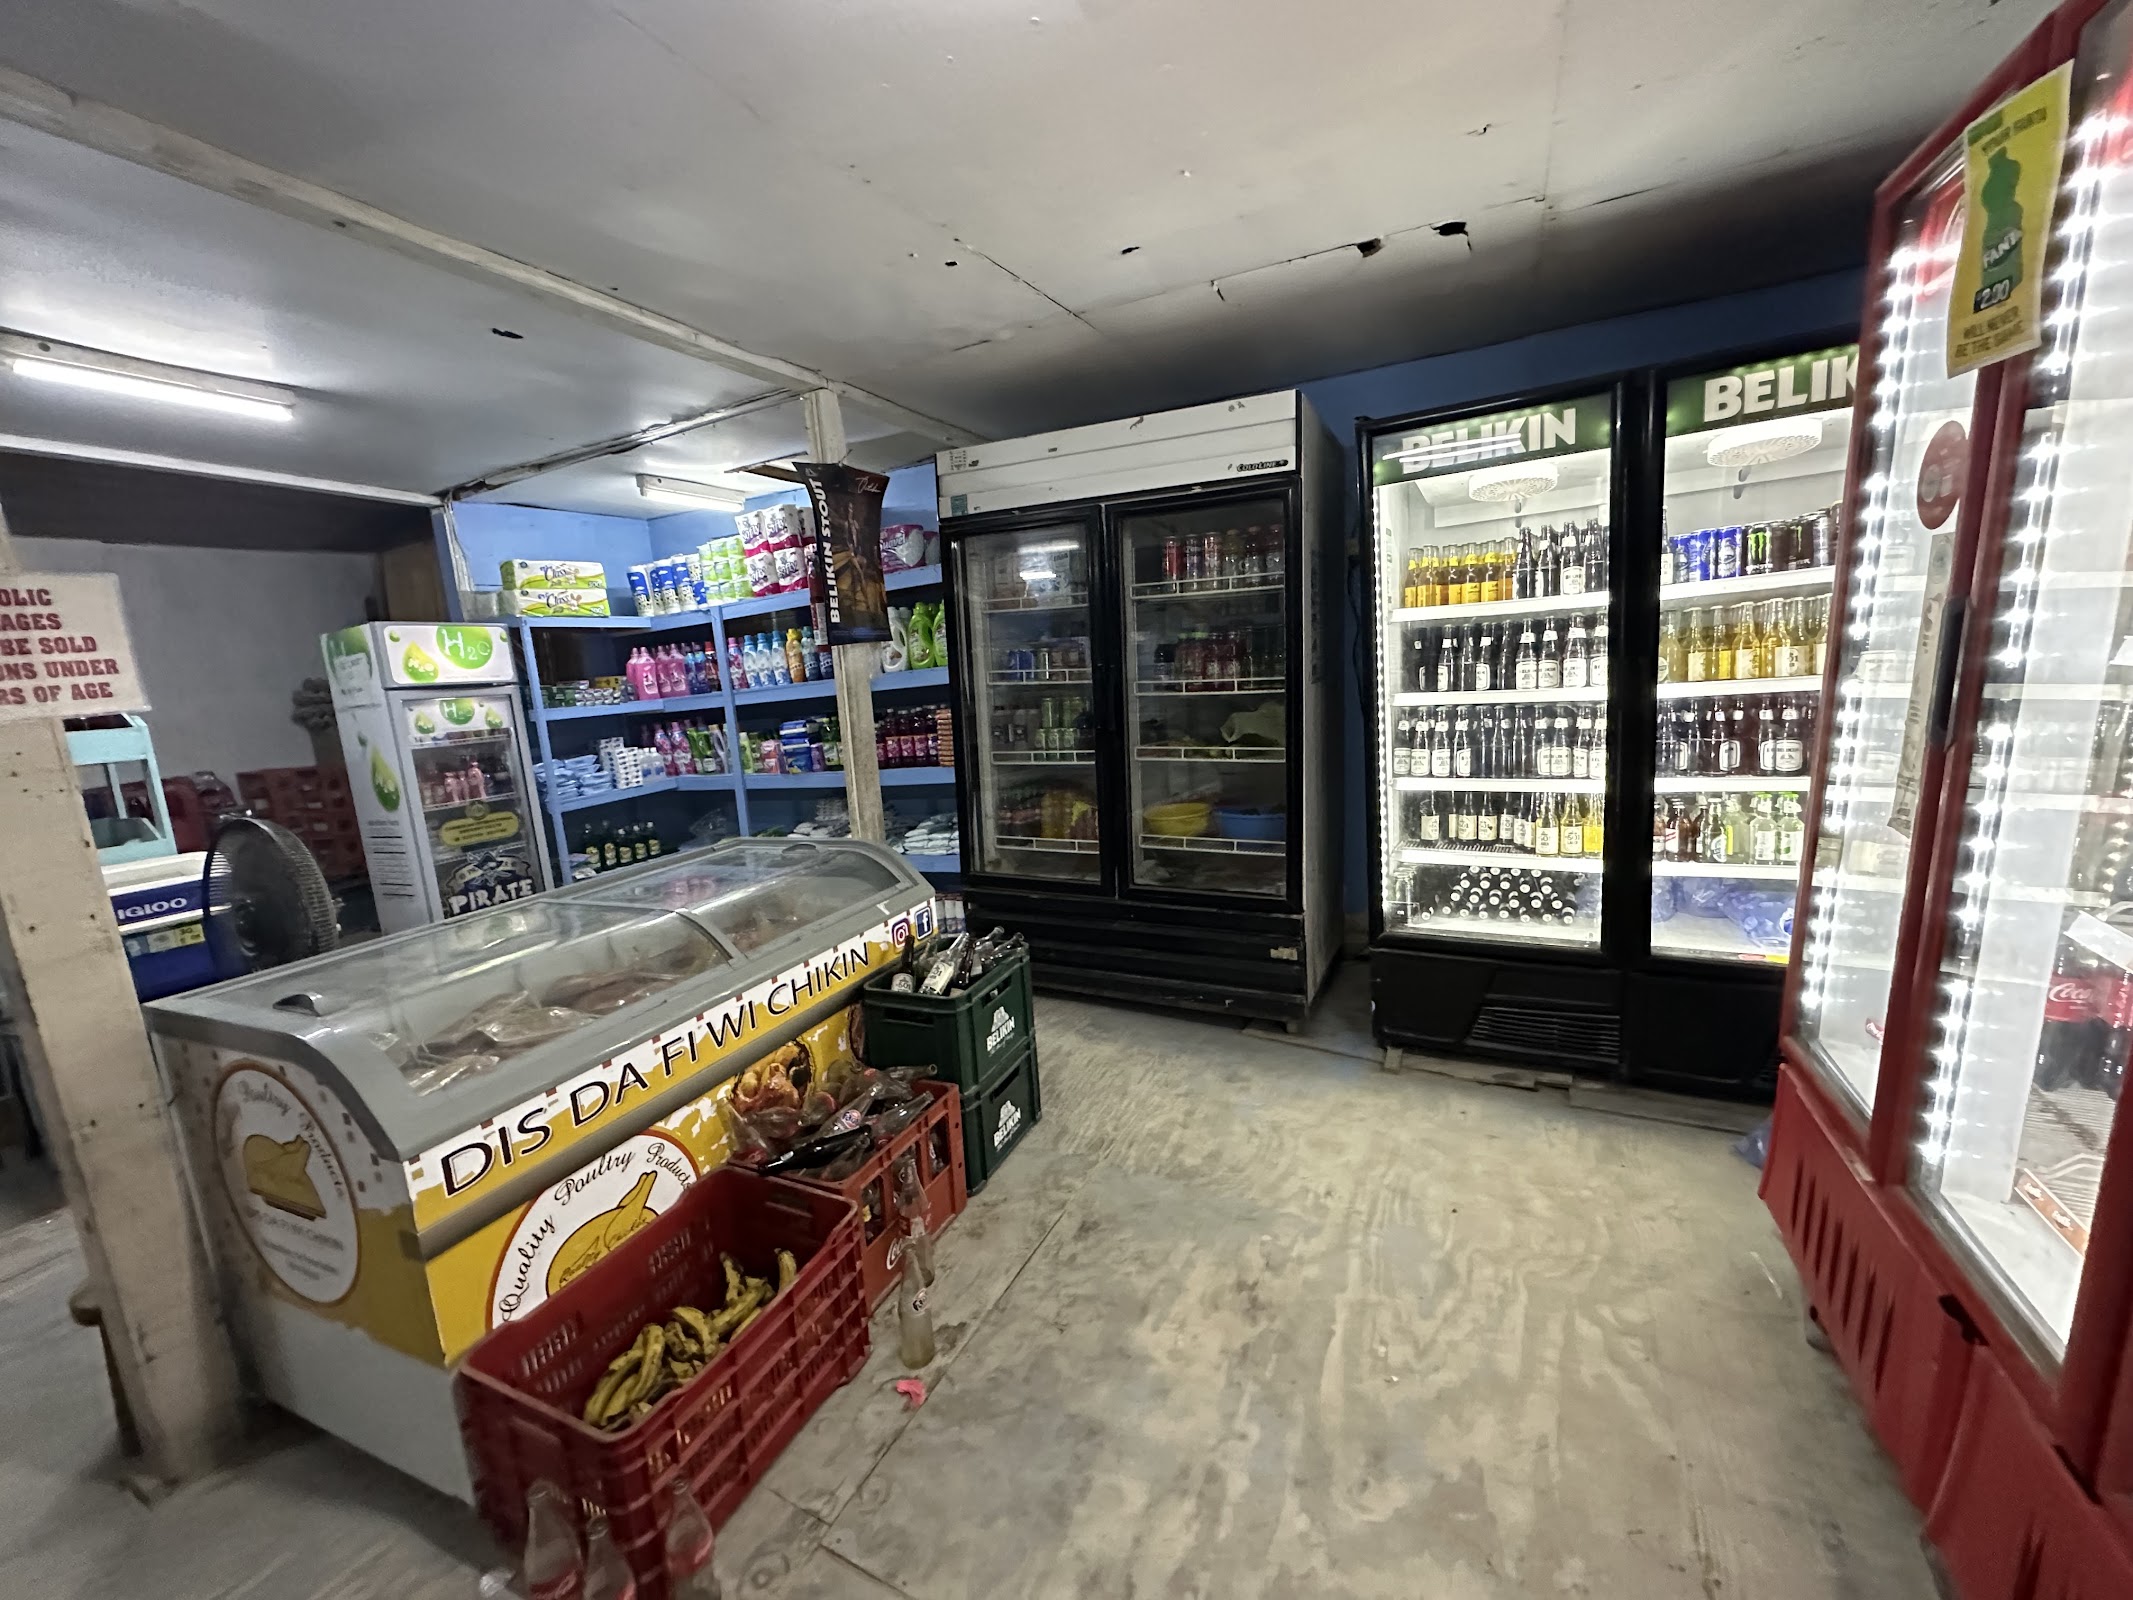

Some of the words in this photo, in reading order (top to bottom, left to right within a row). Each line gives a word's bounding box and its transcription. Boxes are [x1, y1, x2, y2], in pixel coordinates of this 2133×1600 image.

[1402, 407, 1577, 475] BELIKIN
[809, 478, 831, 538] STOUT
[822, 542, 841, 624] BELIKIN
[0, 637, 32, 656] BE
[38, 635, 97, 655] SOLD
[43, 658, 120, 679] UNDER
[33, 684, 61, 703] OF
[71, 682, 114, 701] AGE
[117, 897, 188, 920] IGLOO
[447, 878, 534, 915] PIRATE
[986, 1015, 1016, 1052] BELIKIN
[440, 1107, 552, 1198] DIS
[569, 1061, 649, 1127] DA
[661, 1030, 698, 1078] FI
[706, 1000, 757, 1049] WI
[766, 942, 871, 1017] CHIKIN
[993, 1108, 1022, 1149] BELIKIN
[499, 1214, 556, 1322] Quality
[554, 1150, 636, 1206] Poultry
[646, 1142, 692, 1191] Products
